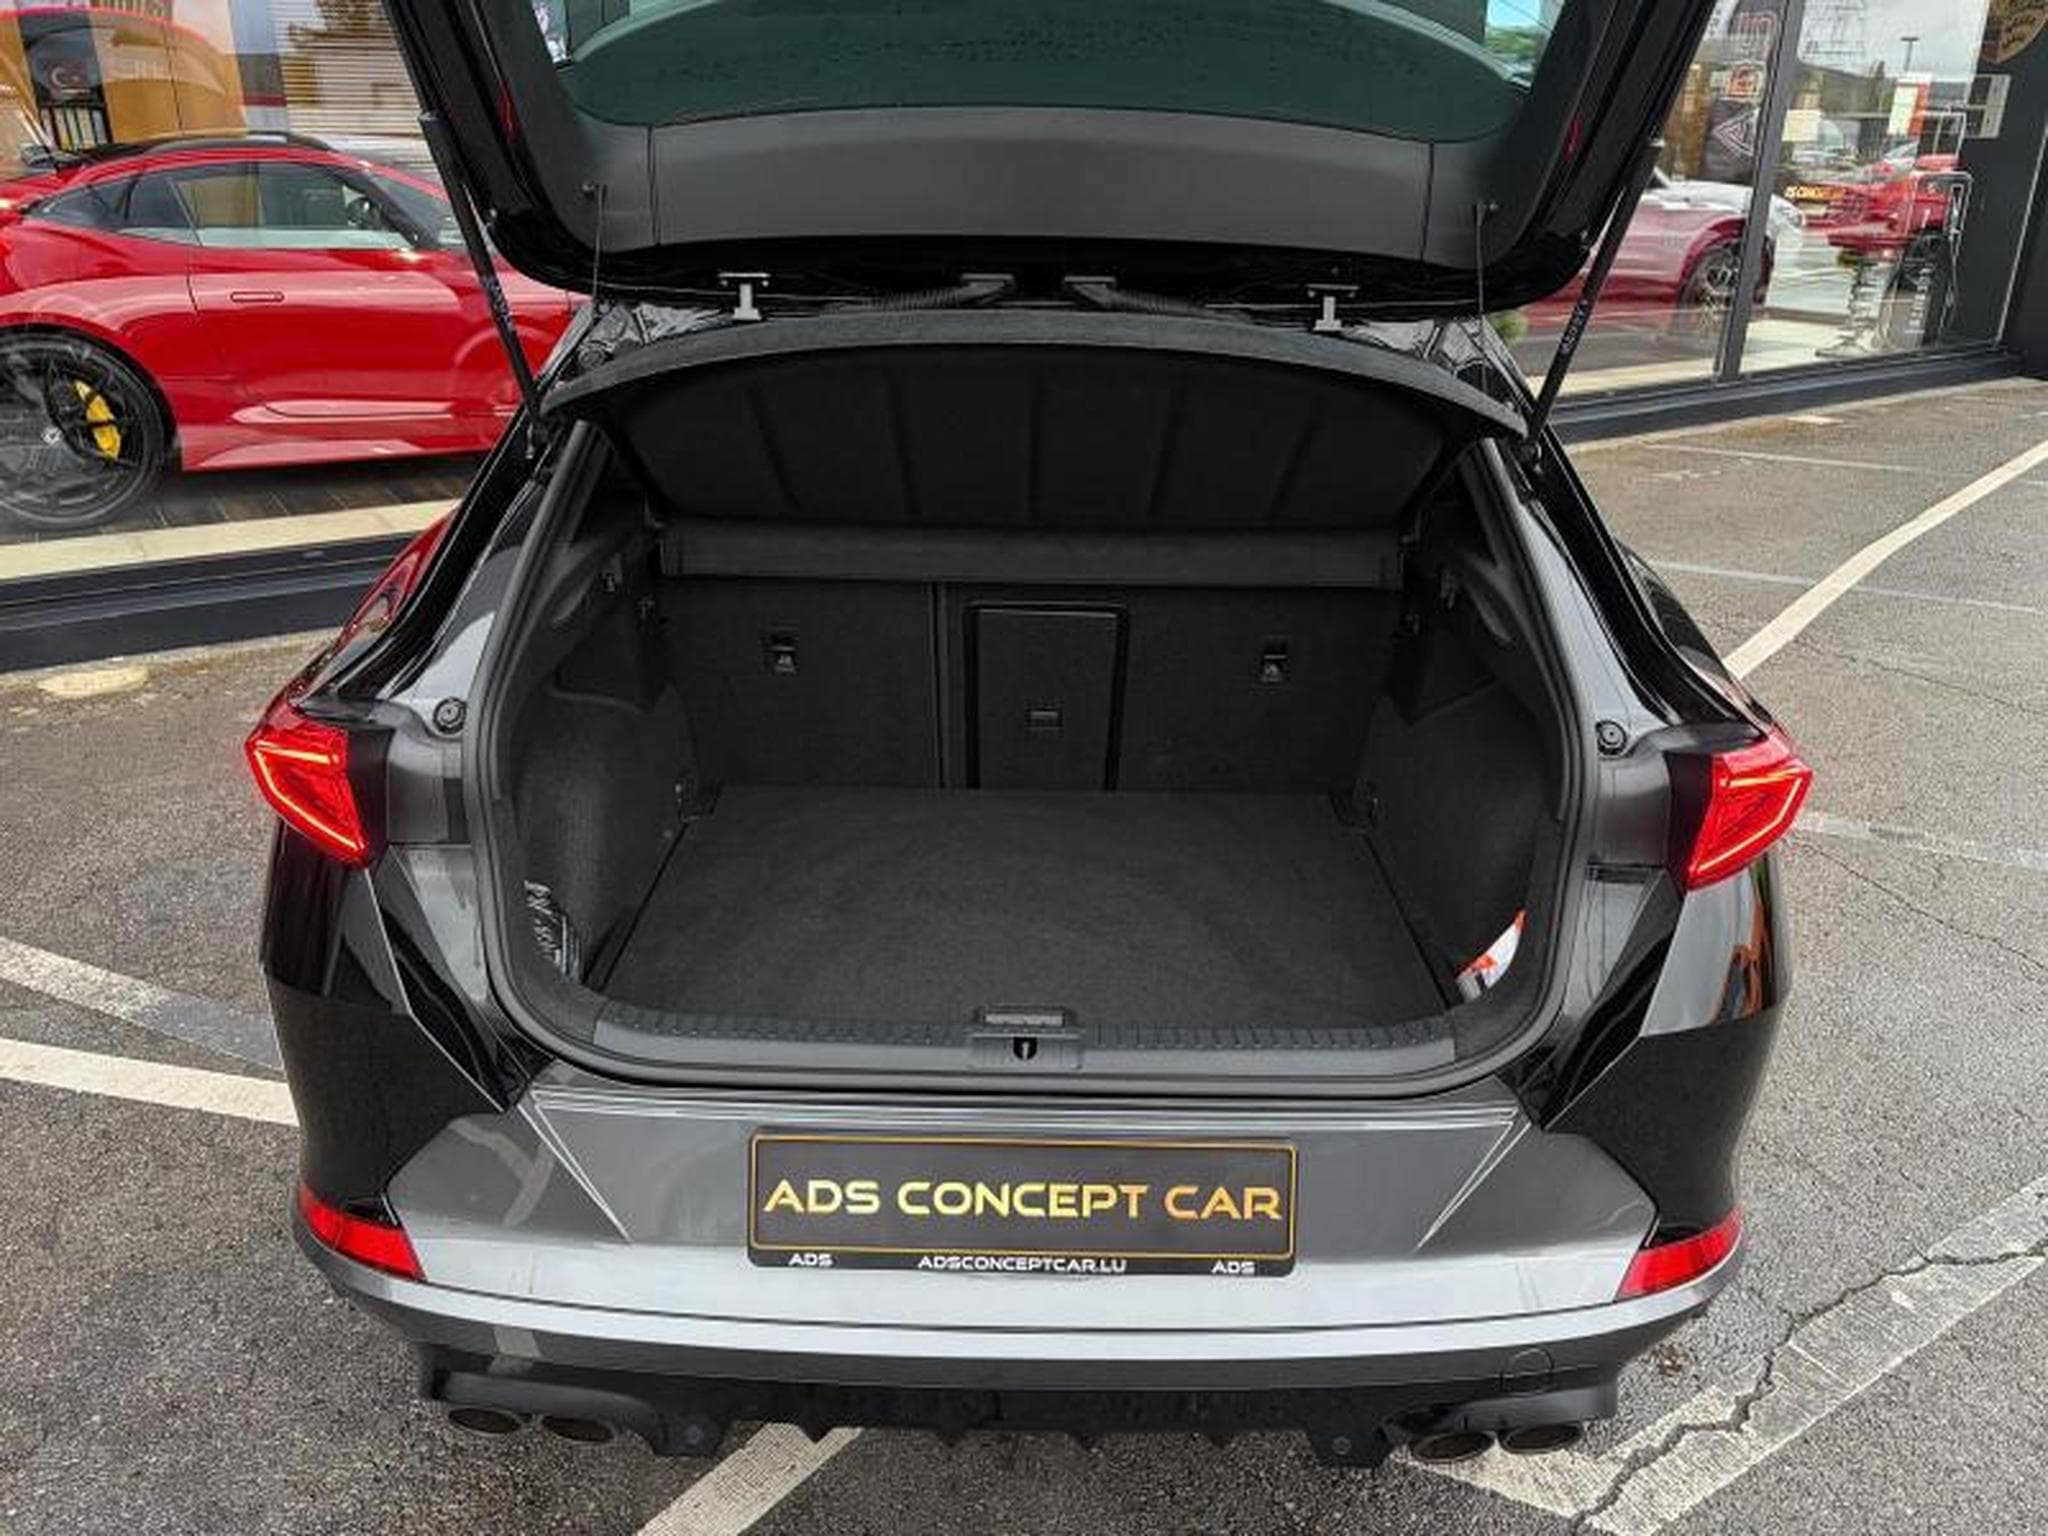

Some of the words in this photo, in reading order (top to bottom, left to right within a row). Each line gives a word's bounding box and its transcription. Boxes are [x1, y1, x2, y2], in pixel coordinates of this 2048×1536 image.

[763, 1179, 881, 1214] ADS
[897, 1181, 1149, 1219] CONCEPT
[1164, 1186, 1282, 1220] CAR
[788, 1253, 834, 1267] ADS
[917, 1255, 1127, 1273] ADSCONCEPTCAR.LU
[1211, 1260, 1256, 1275] ADS
